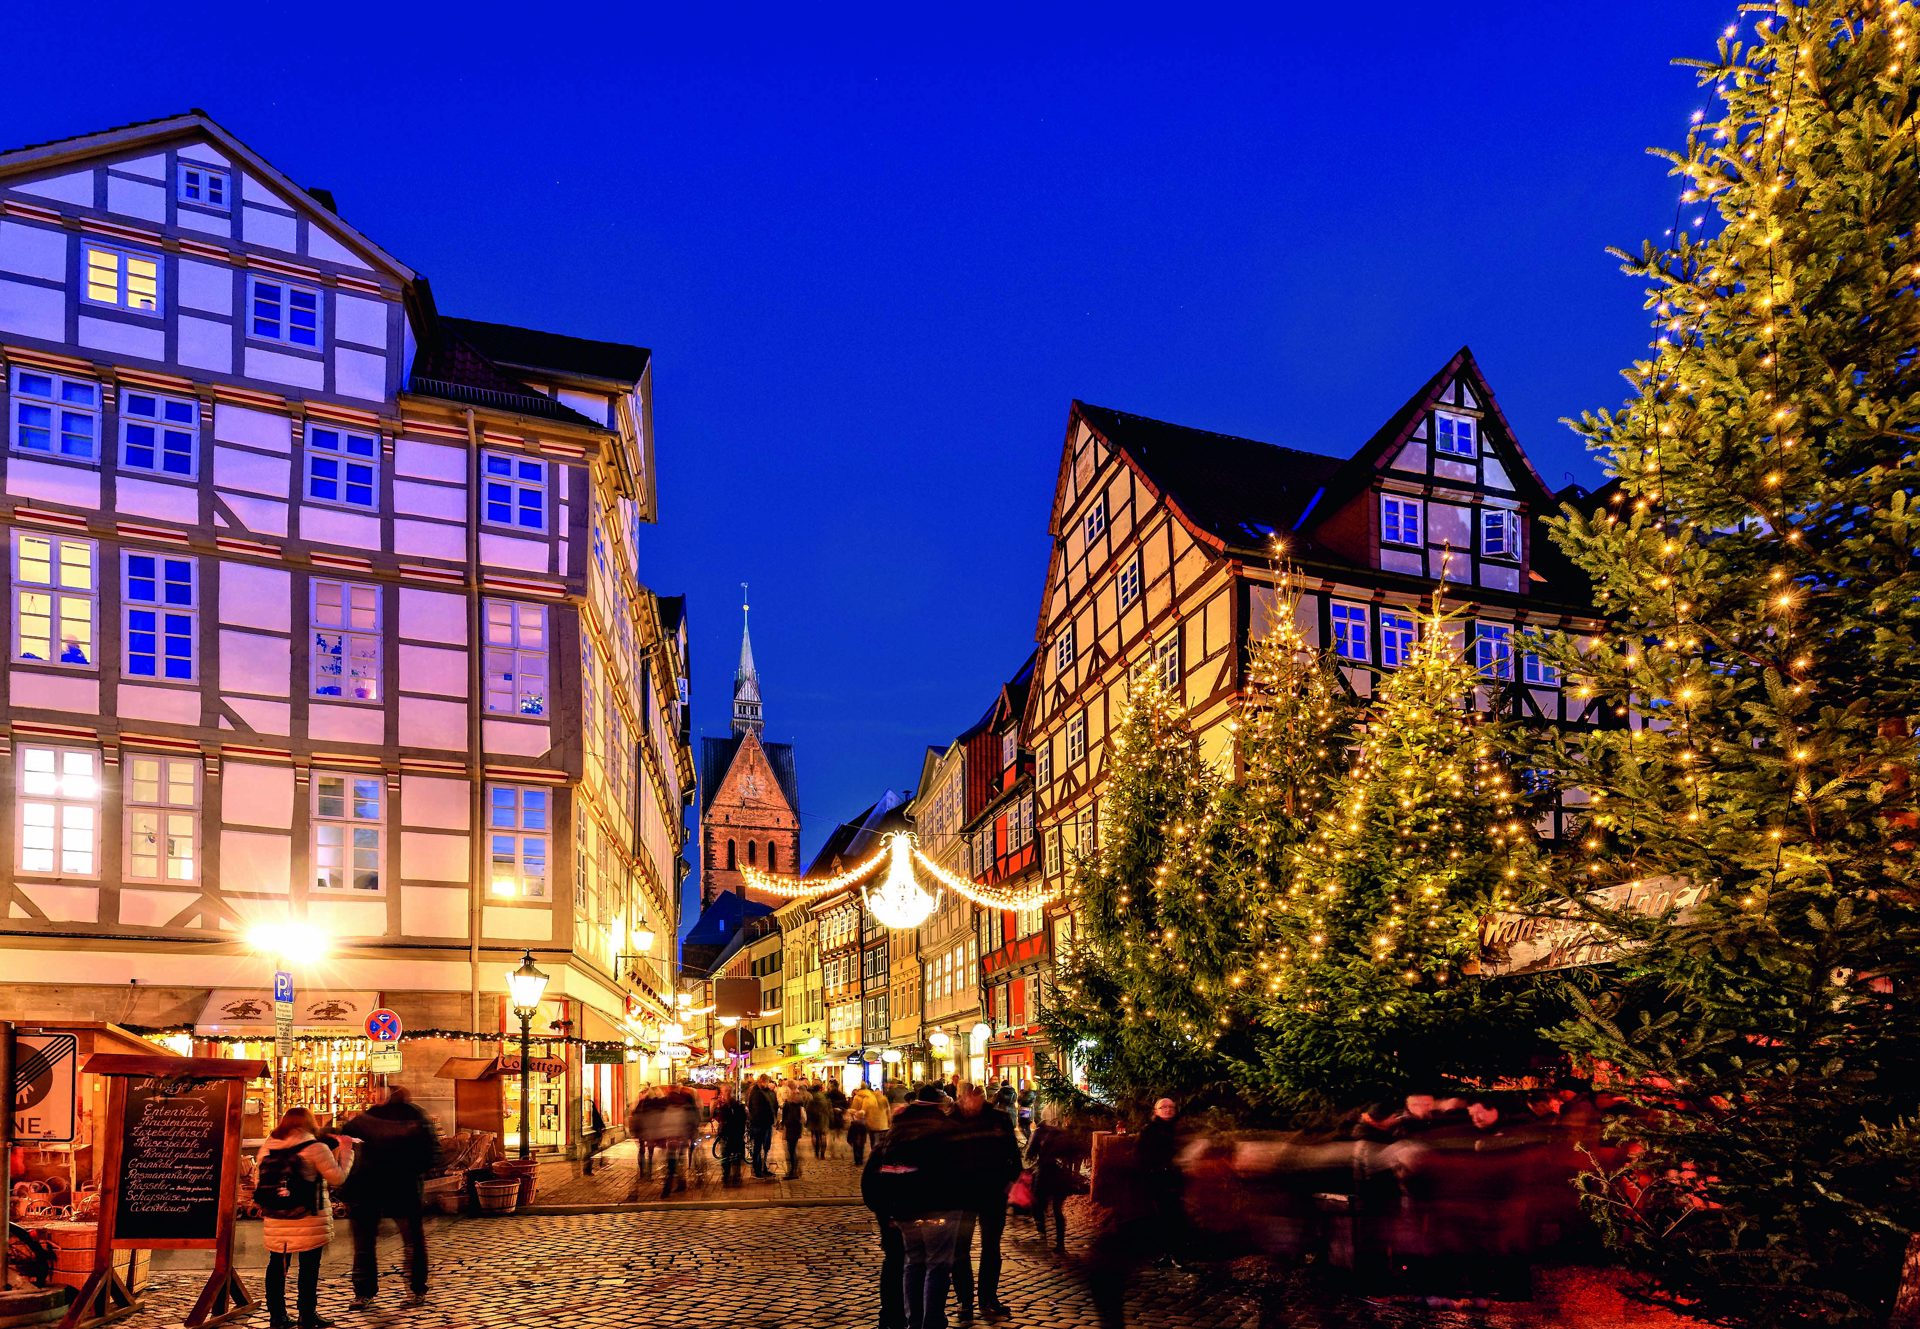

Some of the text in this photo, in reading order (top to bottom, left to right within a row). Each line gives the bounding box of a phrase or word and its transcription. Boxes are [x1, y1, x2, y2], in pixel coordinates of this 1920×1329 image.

[277, 975, 288, 997] P
[501, 1056, 563, 1073] Toetten
[138, 1115, 214, 1128] Krustenbraten
[129, 1126, 210, 1140] Zwiebelfleisch
